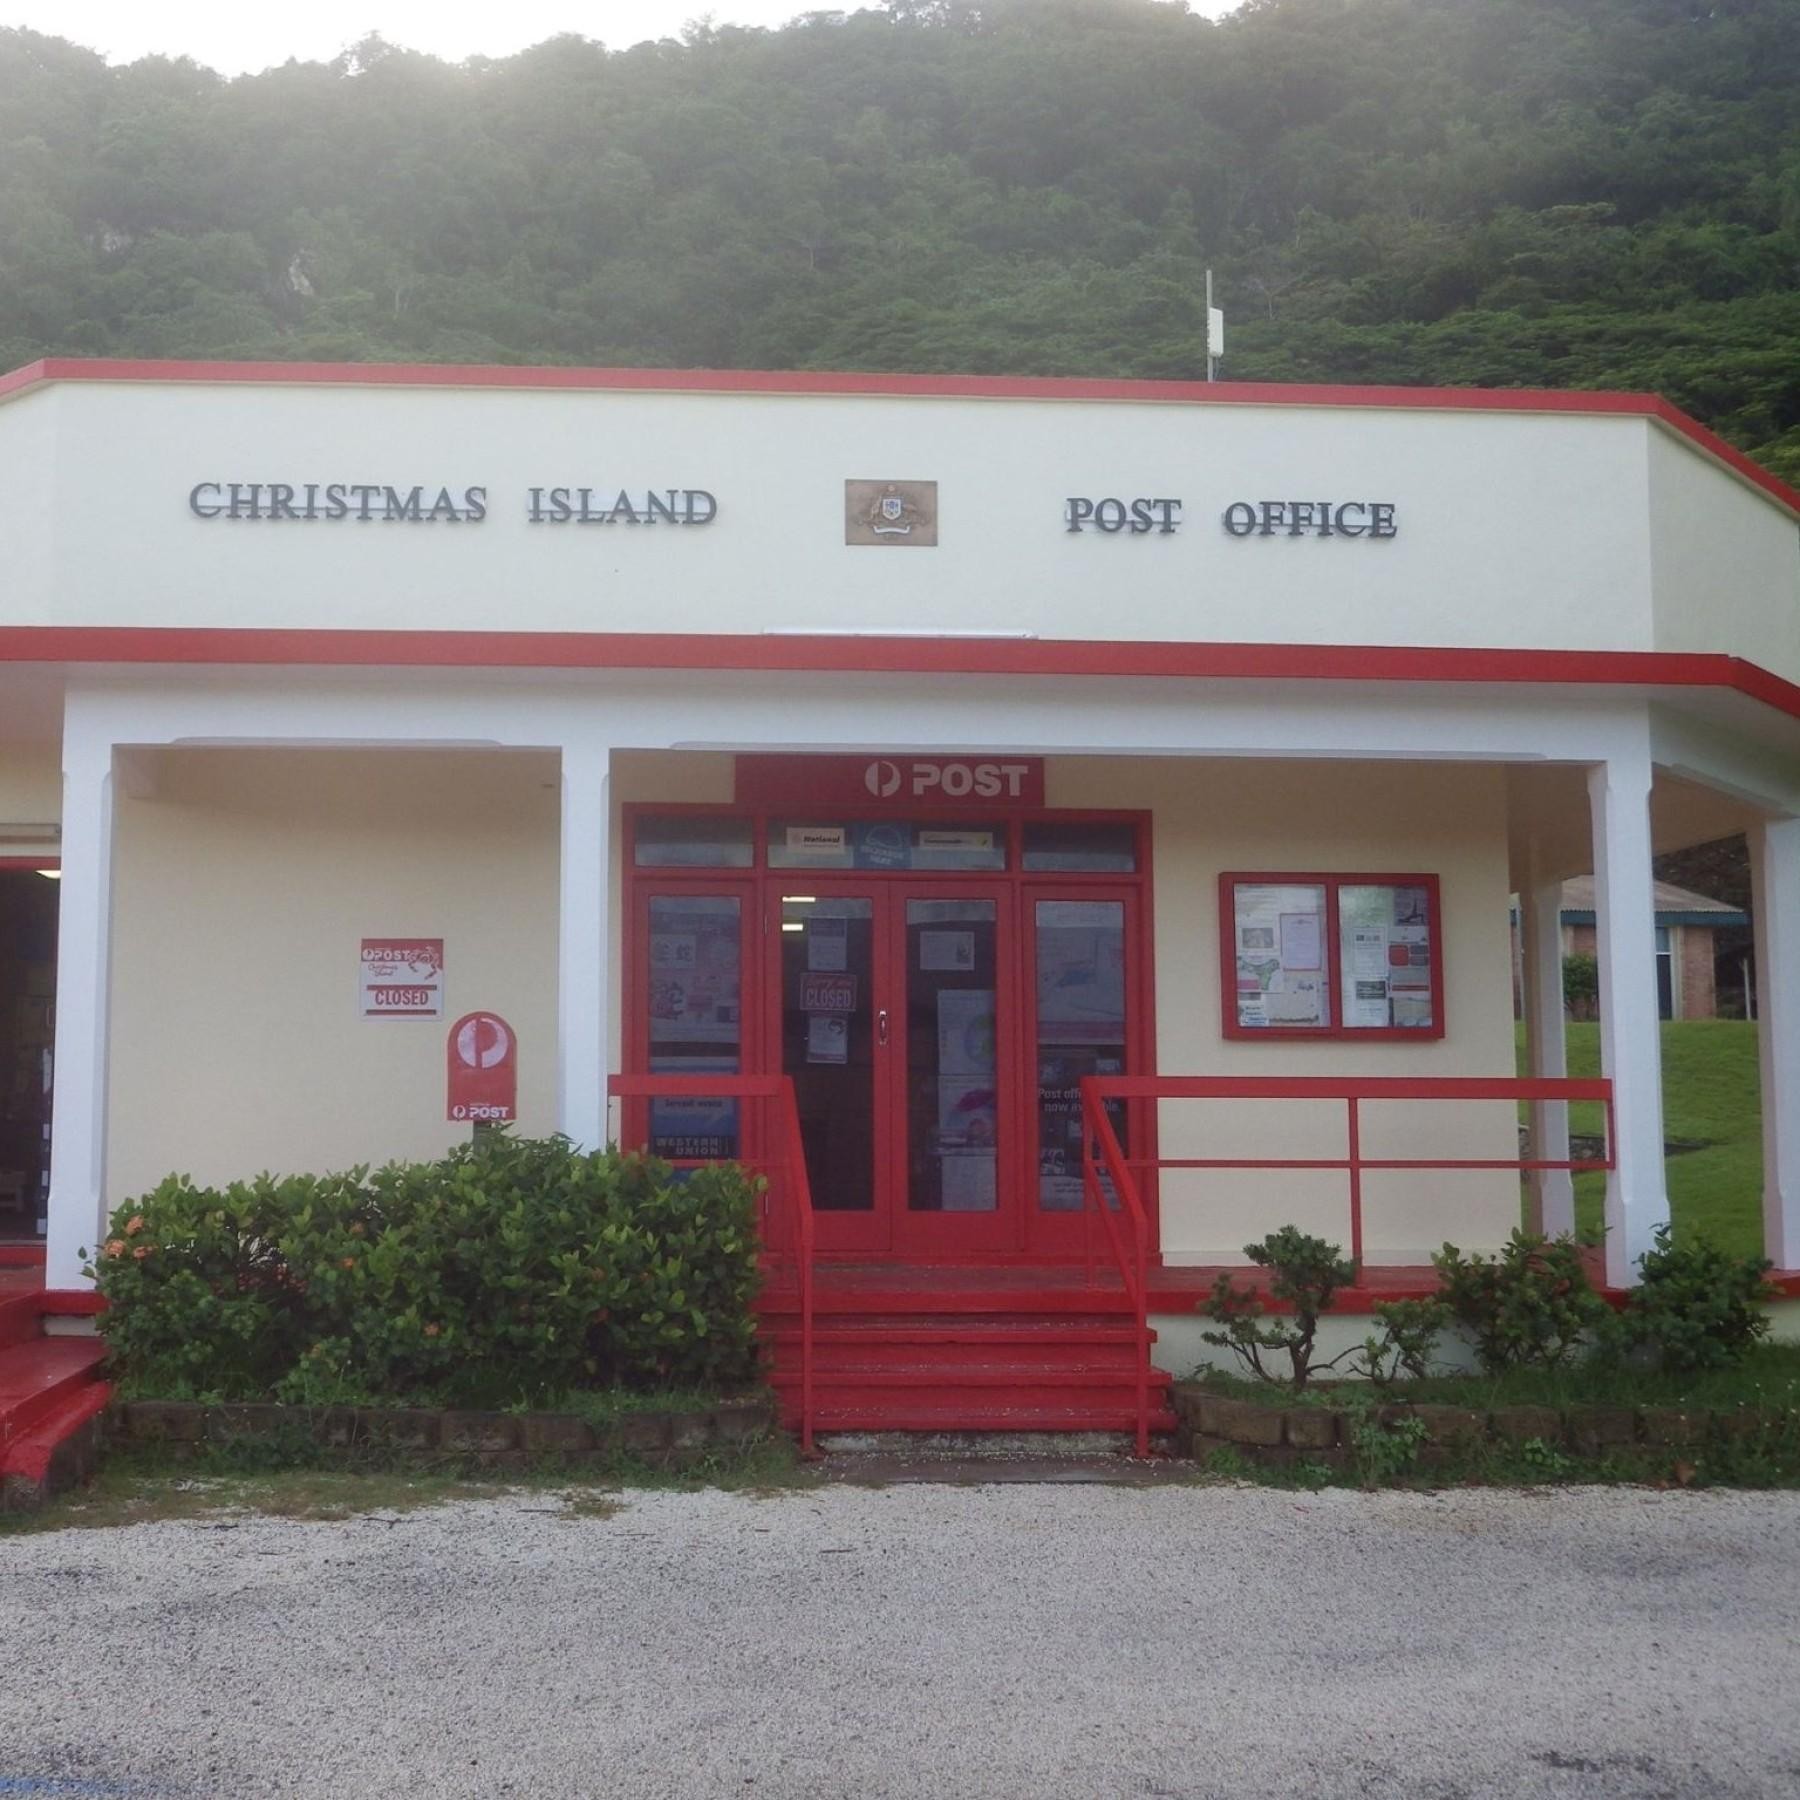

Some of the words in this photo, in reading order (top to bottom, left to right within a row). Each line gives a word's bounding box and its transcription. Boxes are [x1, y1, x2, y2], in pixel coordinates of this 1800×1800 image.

[189, 482, 488, 522] CHRISTMAS
[528, 487, 718, 525] ISLAND
[1066, 498, 1182, 535] POST
[1223, 501, 1398, 538] OFFICE
[912, 763, 1029, 797] POST
[374, 950, 411, 961] POST
[375, 989, 429, 1006] CLOSED
[806, 988, 851, 1008] CLOSED
[1038, 1087, 1062, 1099] Post
[469, 1106, 509, 1119] POST
